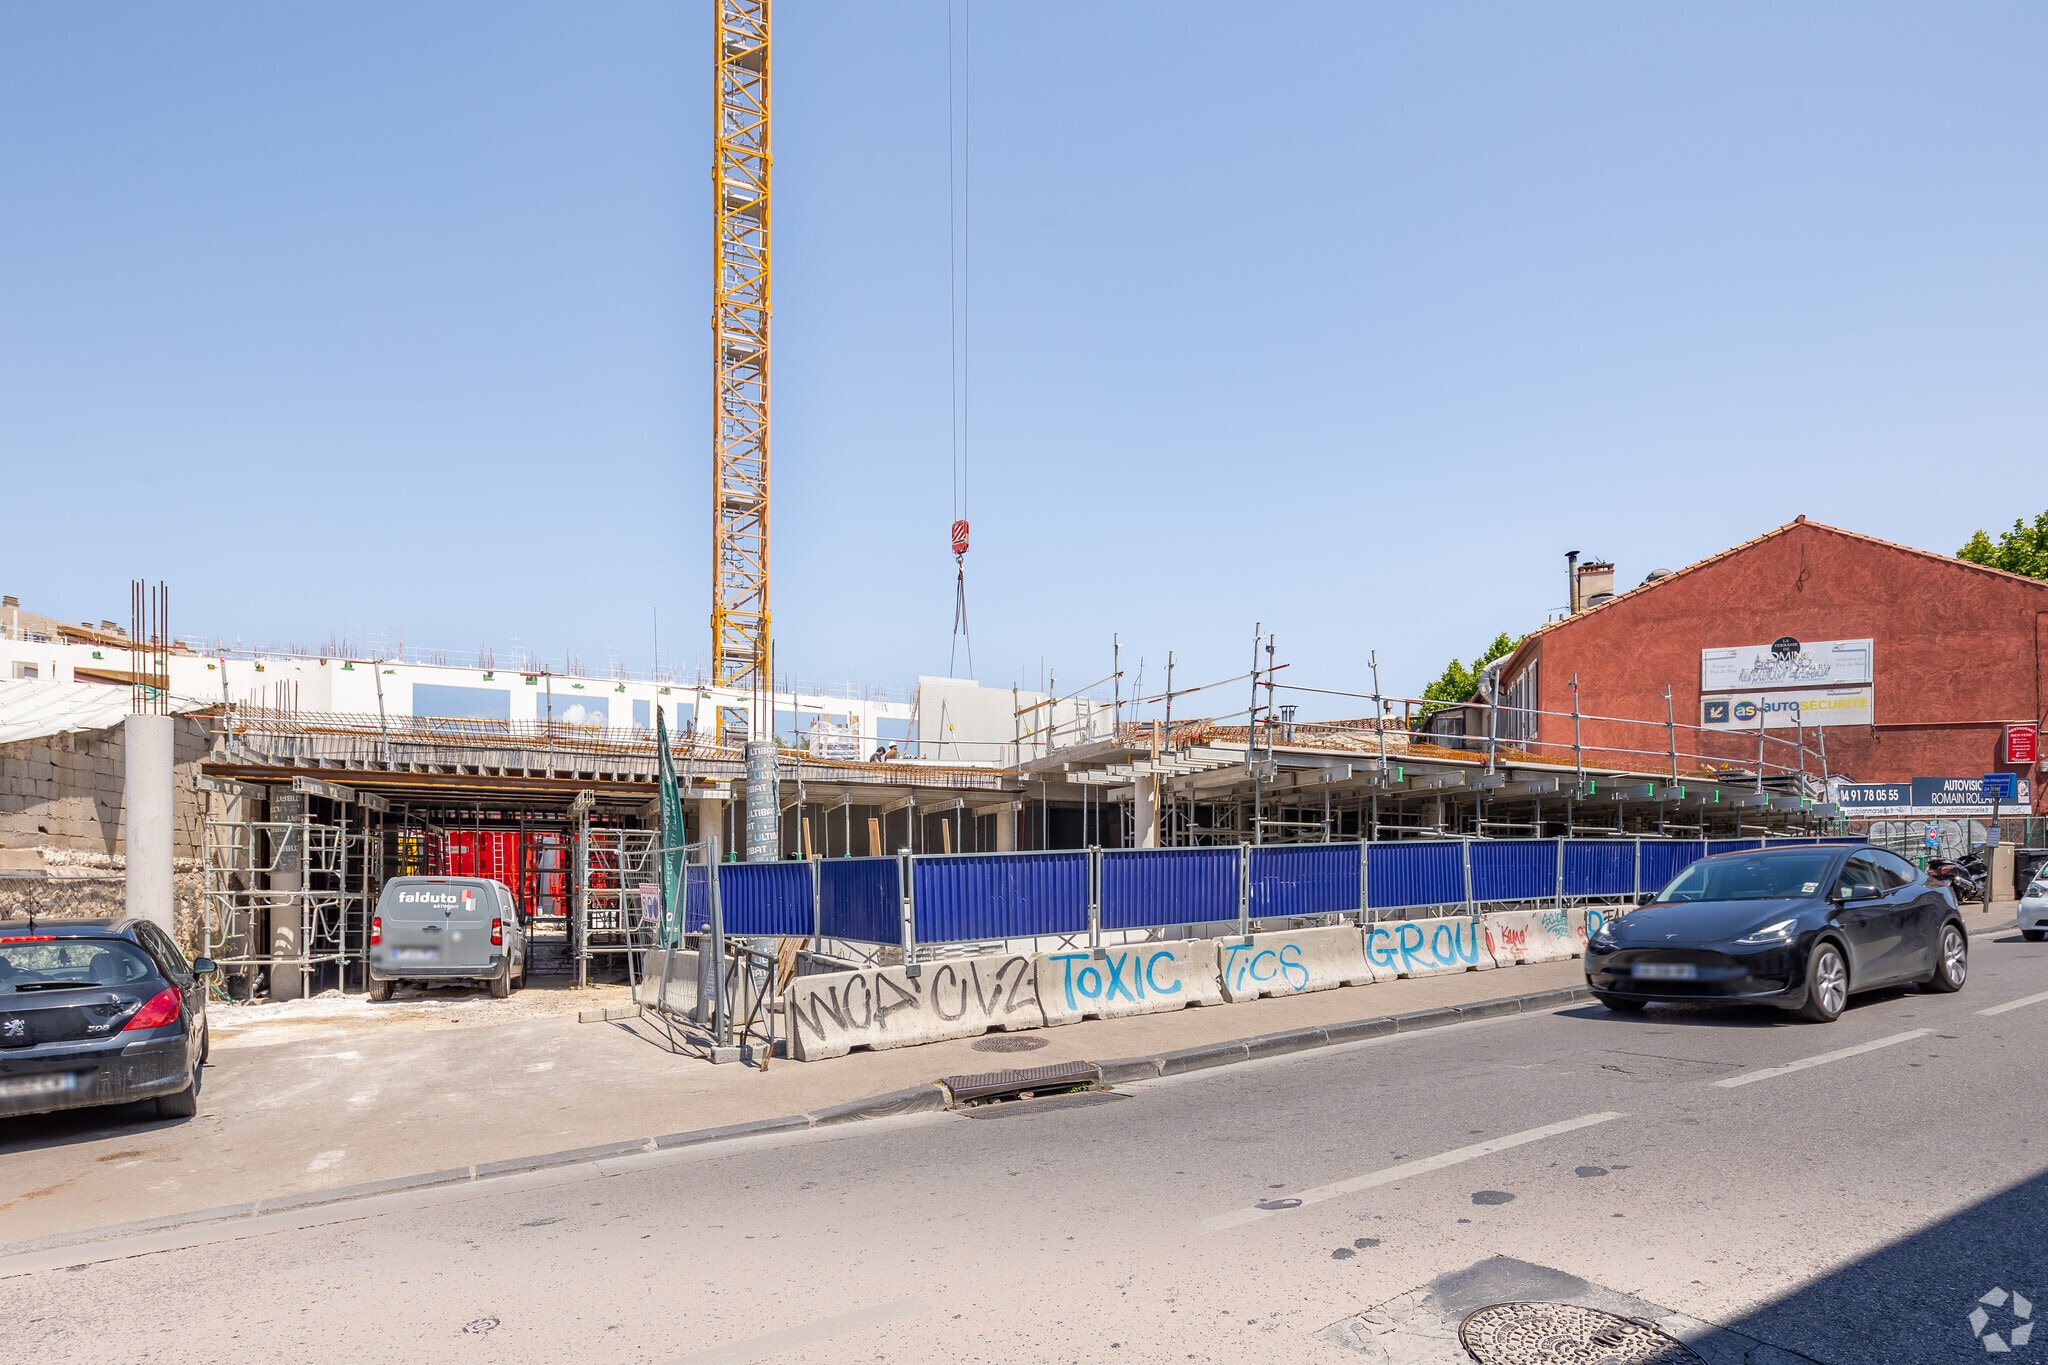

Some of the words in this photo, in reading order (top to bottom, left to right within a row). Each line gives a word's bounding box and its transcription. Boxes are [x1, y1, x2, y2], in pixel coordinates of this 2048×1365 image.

[1840, 790, 1850, 801] 04
[1851, 790, 1861, 801] 91
[1864, 789, 1875, 801] 78
[1876, 789, 1887, 801] 05
[1888, 789, 1899, 800] 55
[1931, 793, 1965, 804] ROMAIN
[398, 892, 457, 903] falduto
